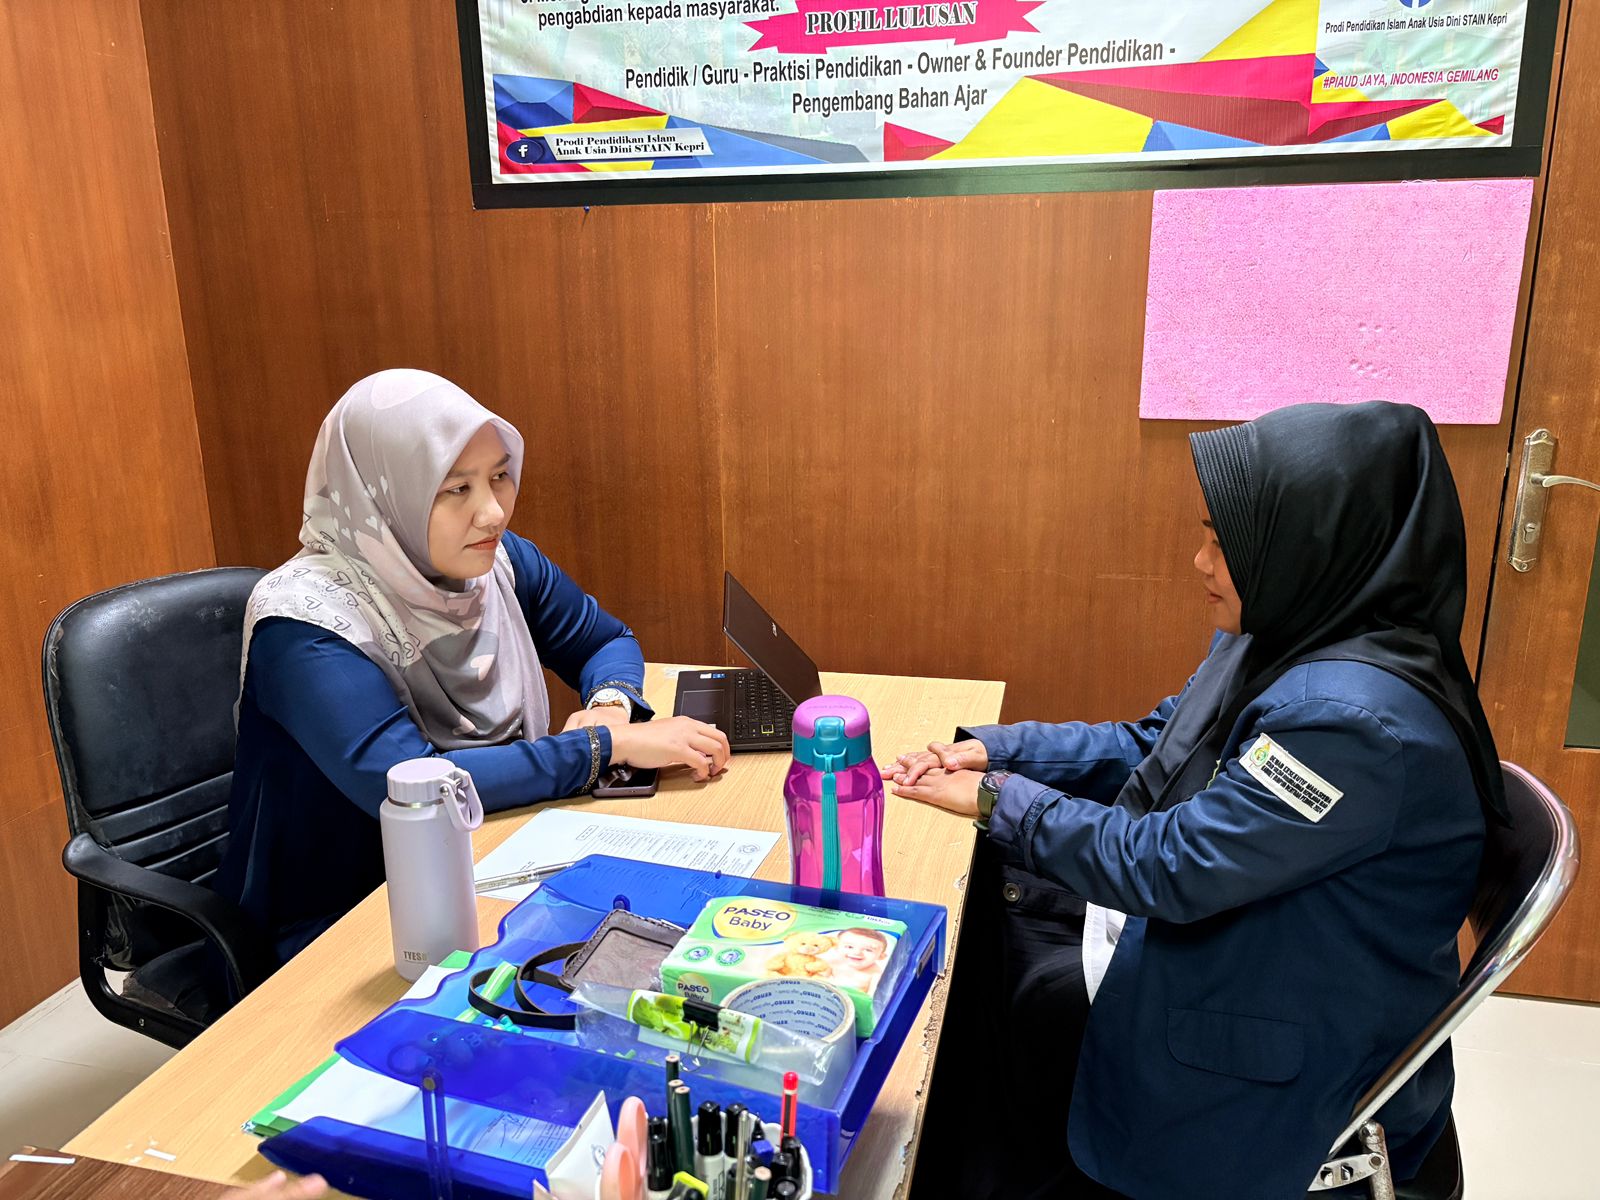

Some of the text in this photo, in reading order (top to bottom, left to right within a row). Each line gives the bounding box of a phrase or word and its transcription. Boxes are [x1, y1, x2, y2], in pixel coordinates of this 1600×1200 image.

[538, 0, 780, 31] pengabdian kepada masyarakat.
[805, 2, 977, 35] PROFIL LULUSAN
[1325, 12, 1508, 33] Prodi Pendidikan Islam Anak Usia Dini STAIN Kepri
[625, 65, 689, 89] Pendidik
[702, 64, 738, 85] Guru
[753, 58, 810, 82] Praktisi
[815, 55, 902, 80] Pendidikan
[917, 51, 970, 74] Owner
[975, 49, 987, 71] &
[992, 46, 1062, 70] Founder
[1067, 39, 1164, 65] Pendidikan
[1323, 68, 1499, 89] #PIAUD JAYA, INDONESIA GEMILANG
[792, 84, 988, 118] Pengembang Bahan Ajar
[556, 134, 676, 146] Prodi Pendidikan Islam
[556, 142, 705, 155] Anak Usia Dini STAIN Kepri
[724, 906, 790, 921] PASEO
[729, 916, 772, 931] Baby
[677, 982, 710, 993] PASEO
